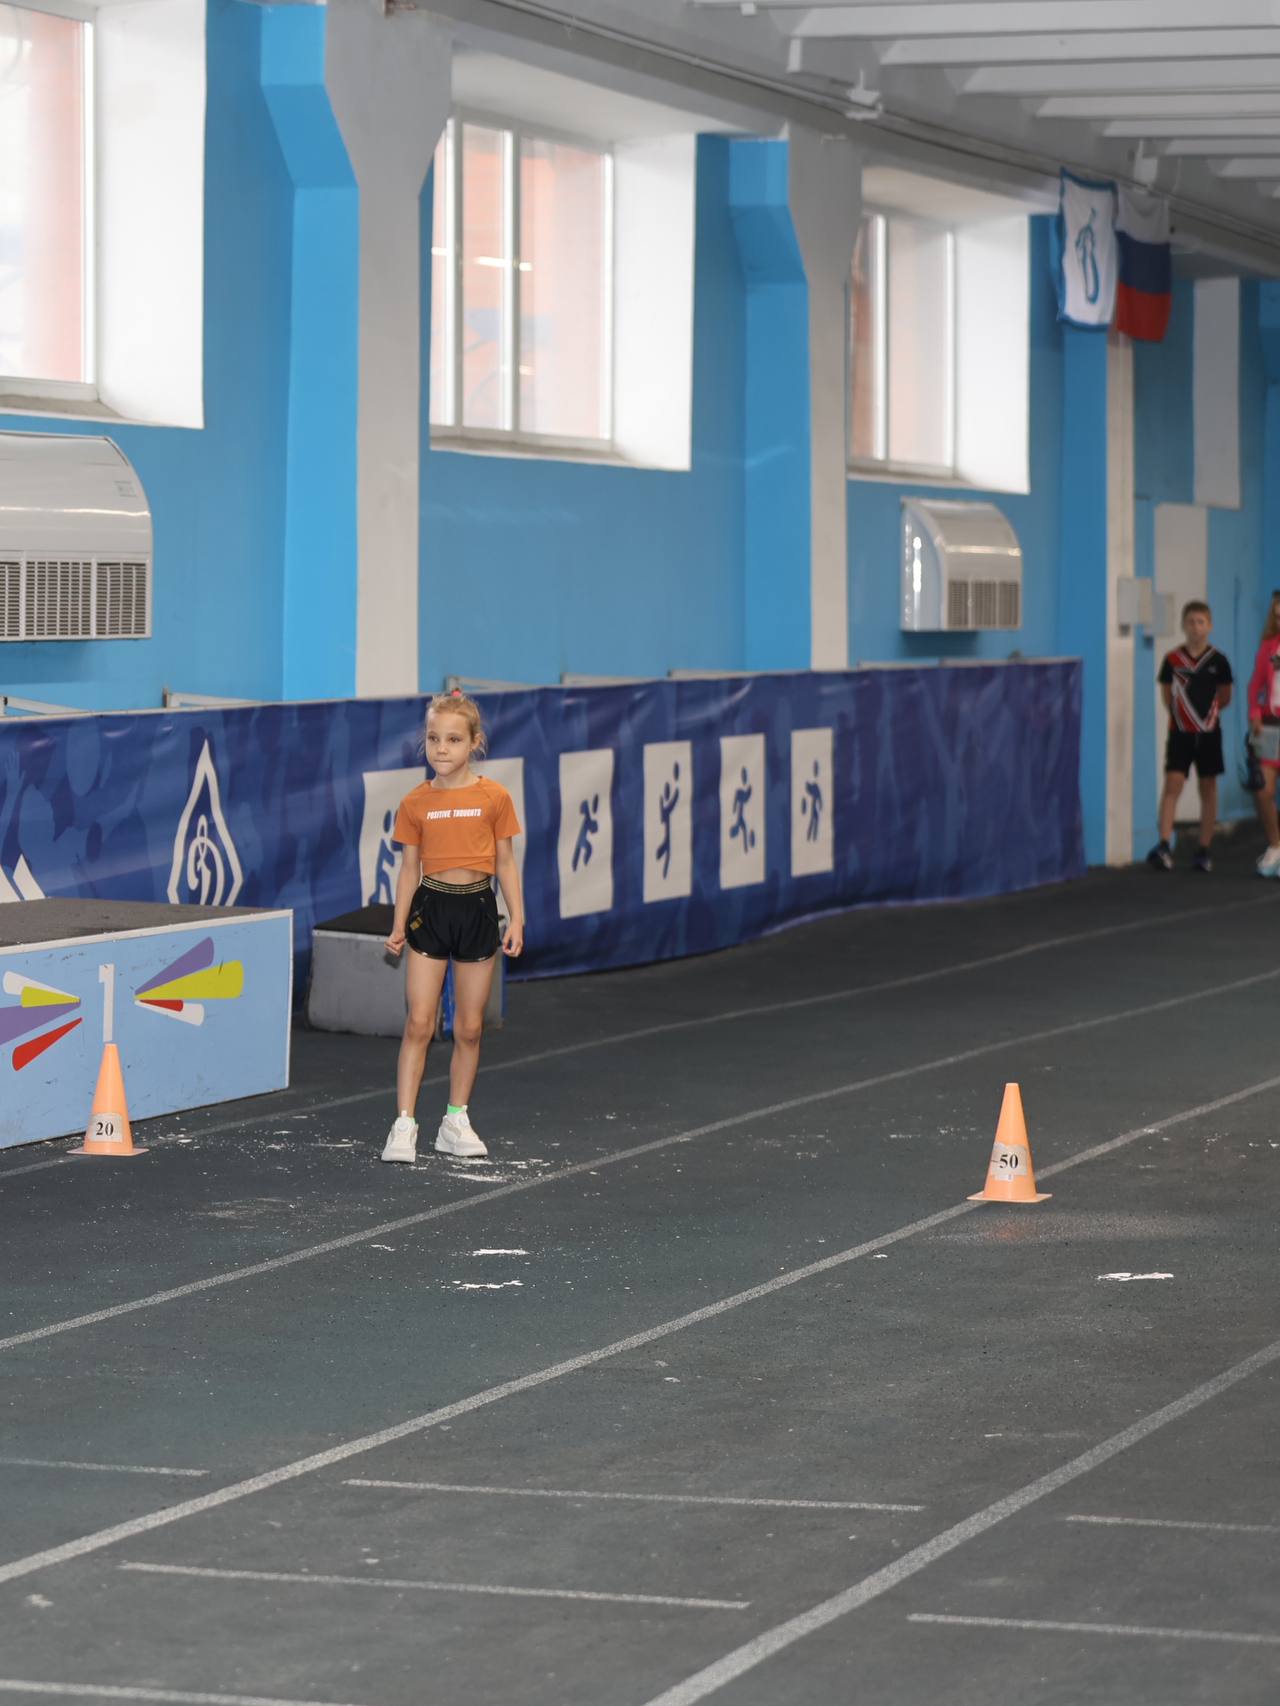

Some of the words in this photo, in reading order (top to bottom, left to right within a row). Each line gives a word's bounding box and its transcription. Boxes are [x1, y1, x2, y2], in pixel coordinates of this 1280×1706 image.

[98, 963, 115, 1042] 1
[95, 1121, 114, 1136] 20
[999, 1154, 1019, 1169] 50
